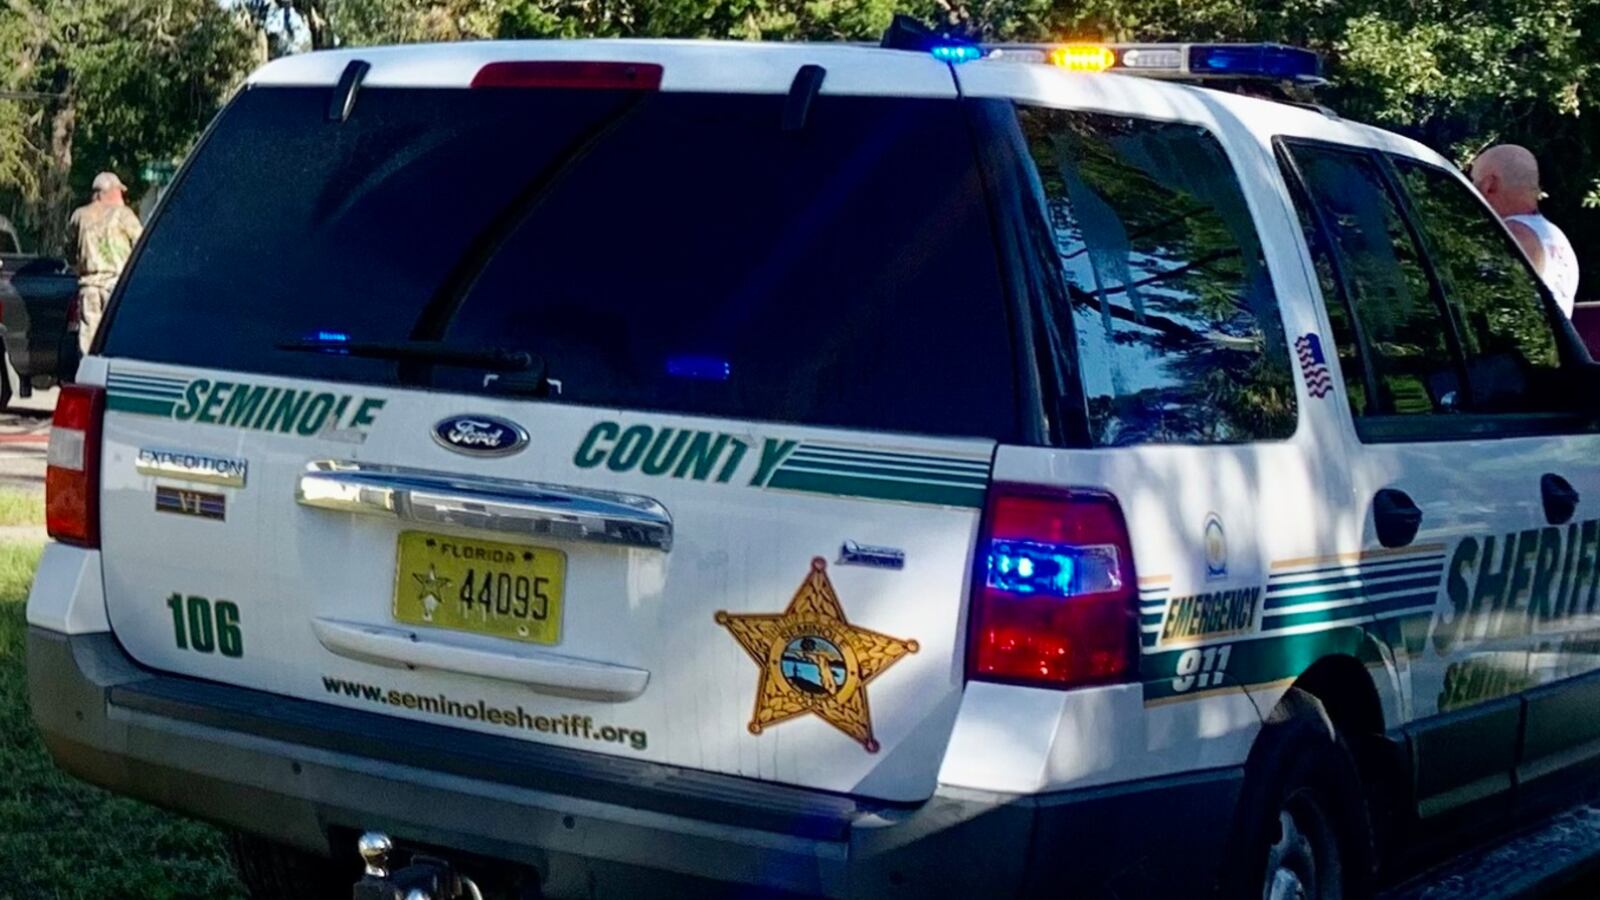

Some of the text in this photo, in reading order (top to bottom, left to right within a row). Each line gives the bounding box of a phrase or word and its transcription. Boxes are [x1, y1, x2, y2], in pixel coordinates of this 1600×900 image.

[175, 379, 798, 487] SEMINOLE COUNTY
[448, 419, 503, 447] Ford
[138, 447, 247, 476] EXPEDITION
[441, 543, 515, 563] FLORIDA
[459, 568, 549, 621] 44095
[1162, 586, 1261, 639] EMERGENCY
[166, 591, 244, 659] 106
[1172, 644, 1232, 692] 911
[321, 676, 648, 750] www.seminolesheriff.org
